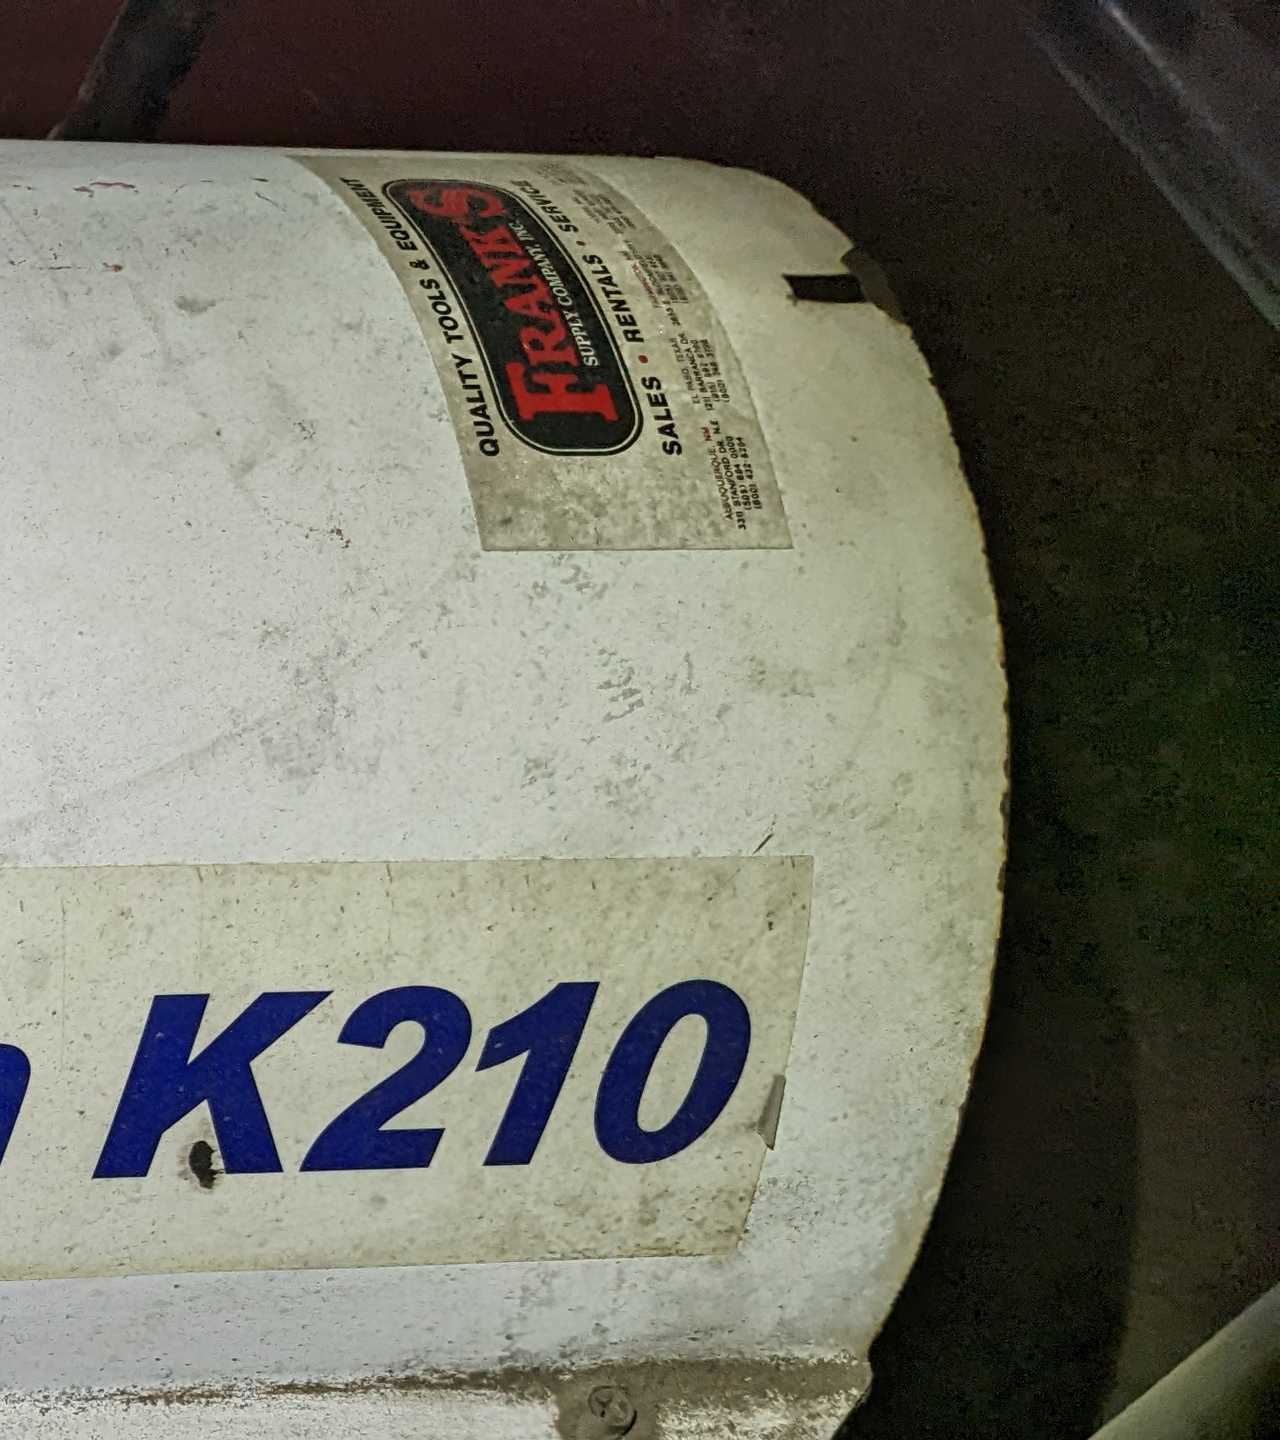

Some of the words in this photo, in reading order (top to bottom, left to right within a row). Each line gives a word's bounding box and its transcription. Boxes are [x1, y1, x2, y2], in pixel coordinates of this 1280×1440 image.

[339, 176, 419, 253] EQUIPMENT
[510, 179, 580, 234] SERVICE
[408, 185, 620, 423] FRANK'S
[409, 259, 431, 271] &
[582, 253, 645, 344] RENTALS
[420, 277, 464, 344] TOOLS
[563, 310, 600, 368] SUPPLY
[452, 353, 500, 457] QUALITY
[641, 376, 683, 457] SALES
[93, 977, 754, 1179] K210
